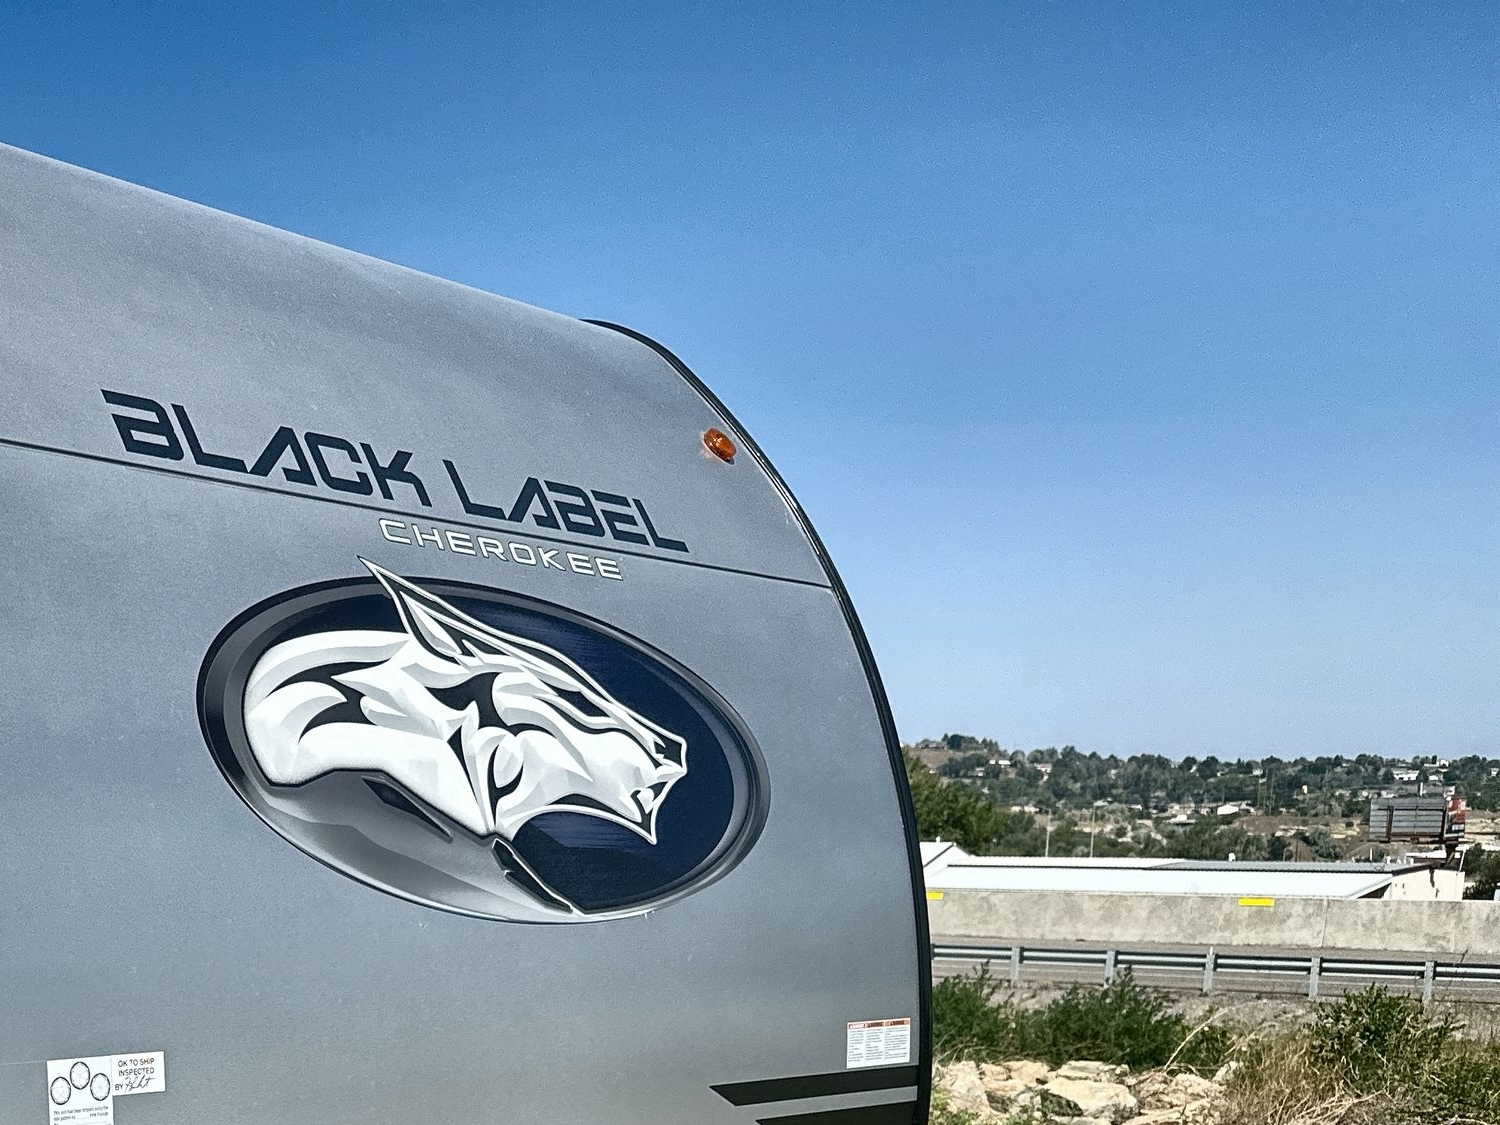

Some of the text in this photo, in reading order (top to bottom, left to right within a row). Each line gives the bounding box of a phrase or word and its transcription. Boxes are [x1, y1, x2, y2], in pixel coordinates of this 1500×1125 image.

[100, 388, 688, 553] BLACK LABEL
[378, 518, 624, 581] CHEROKEE
[117, 1057, 155, 1068] OK TO SHIP
[118, 1067, 155, 1077] INSPECTED
[114, 1083, 124, 1091] BY
